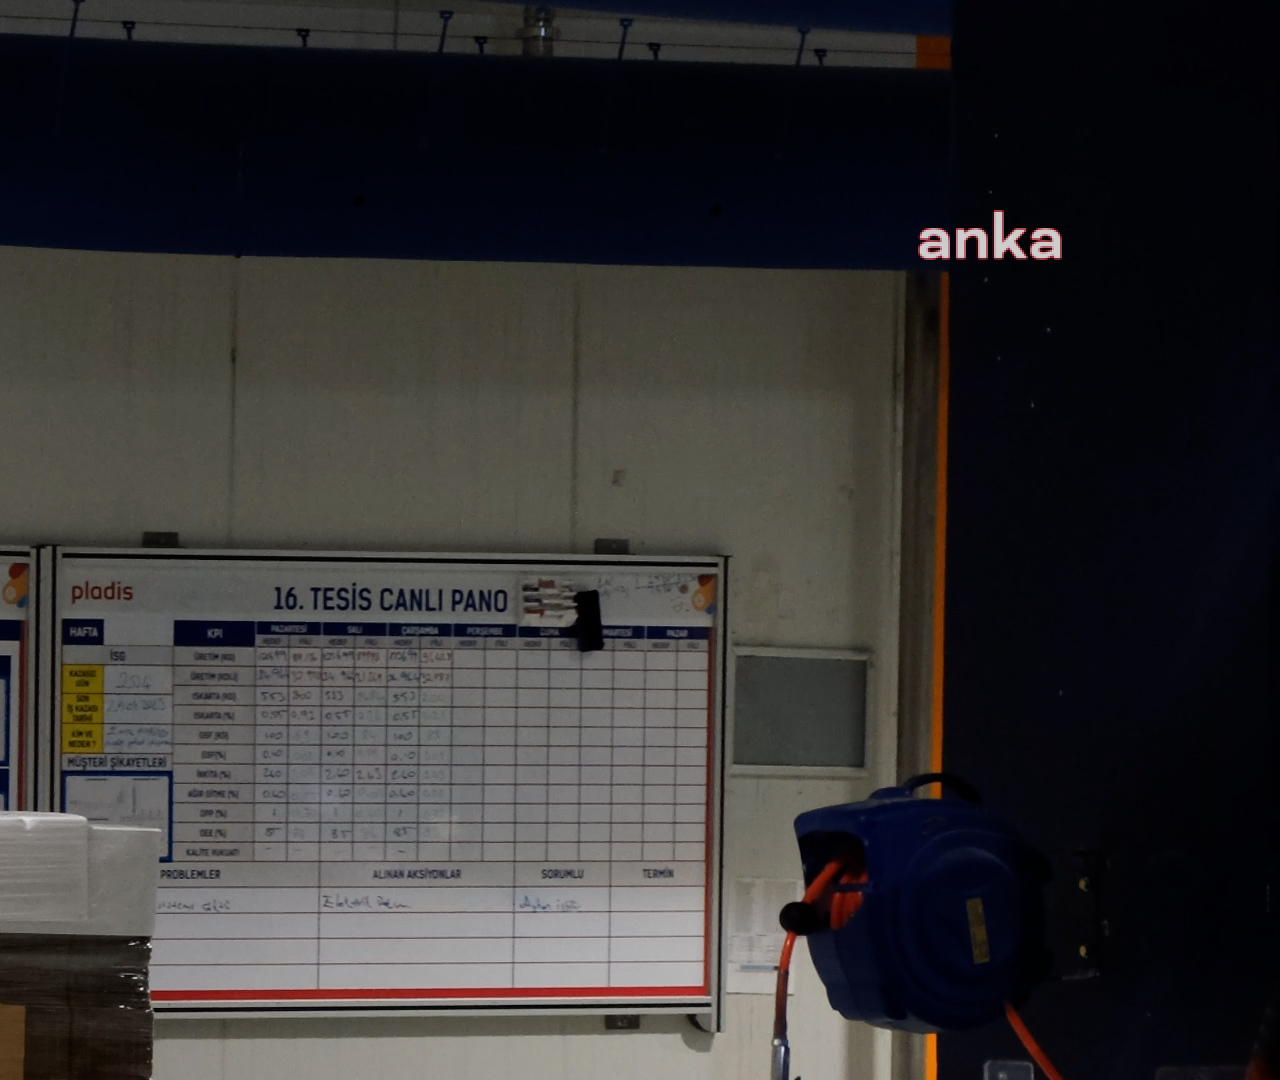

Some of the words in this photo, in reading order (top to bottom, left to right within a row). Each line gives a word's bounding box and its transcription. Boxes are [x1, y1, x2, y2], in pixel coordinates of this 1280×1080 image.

[71, 581, 134, 604] pladis
[273, 586, 304, 611] 16.
[310, 582, 372, 611] TESİS
[380, 587, 443, 612] CANLI
[451, 588, 508, 613] PANO
[69, 627, 98, 637] HAFTA
[207, 628, 223, 638] KPI
[110, 649, 126, 661] İSG
[67, 755, 107, 769] MÜŞTERİ
[160, 869, 220, 879] PROBLEMLER
[373, 869, 404, 880] ALINAN
[406, 867, 461, 880] AKSİYONLAR
[541, 869, 584, 879] SORUMLU
[642, 867, 675, 879] TERMİN
